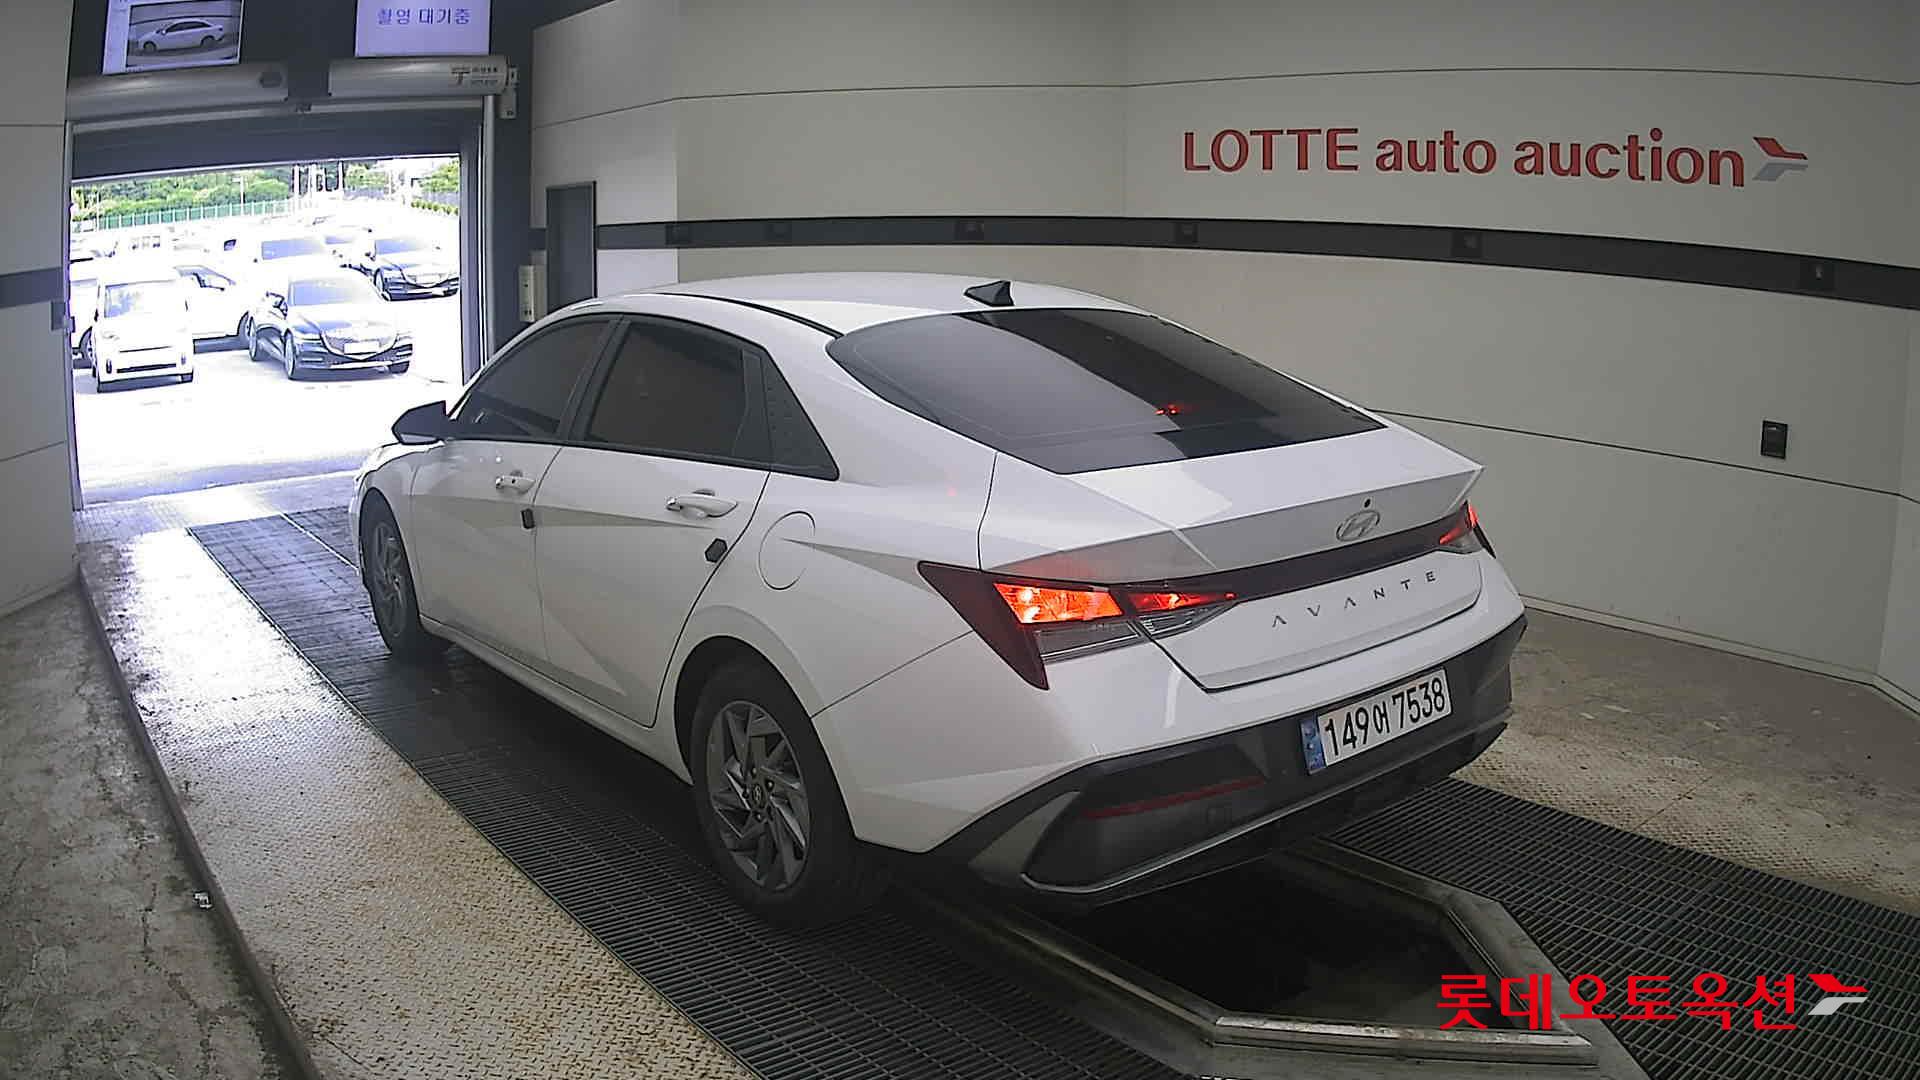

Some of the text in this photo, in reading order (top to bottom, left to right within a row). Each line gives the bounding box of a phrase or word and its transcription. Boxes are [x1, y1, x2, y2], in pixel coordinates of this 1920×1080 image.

[418, 8, 471, 25] 대기중
[1183, 127, 1745, 188] LOTTE auto auction
[1271, 570, 1437, 628] AVANTE
[1323, 677, 1446, 757] 149어 7538
